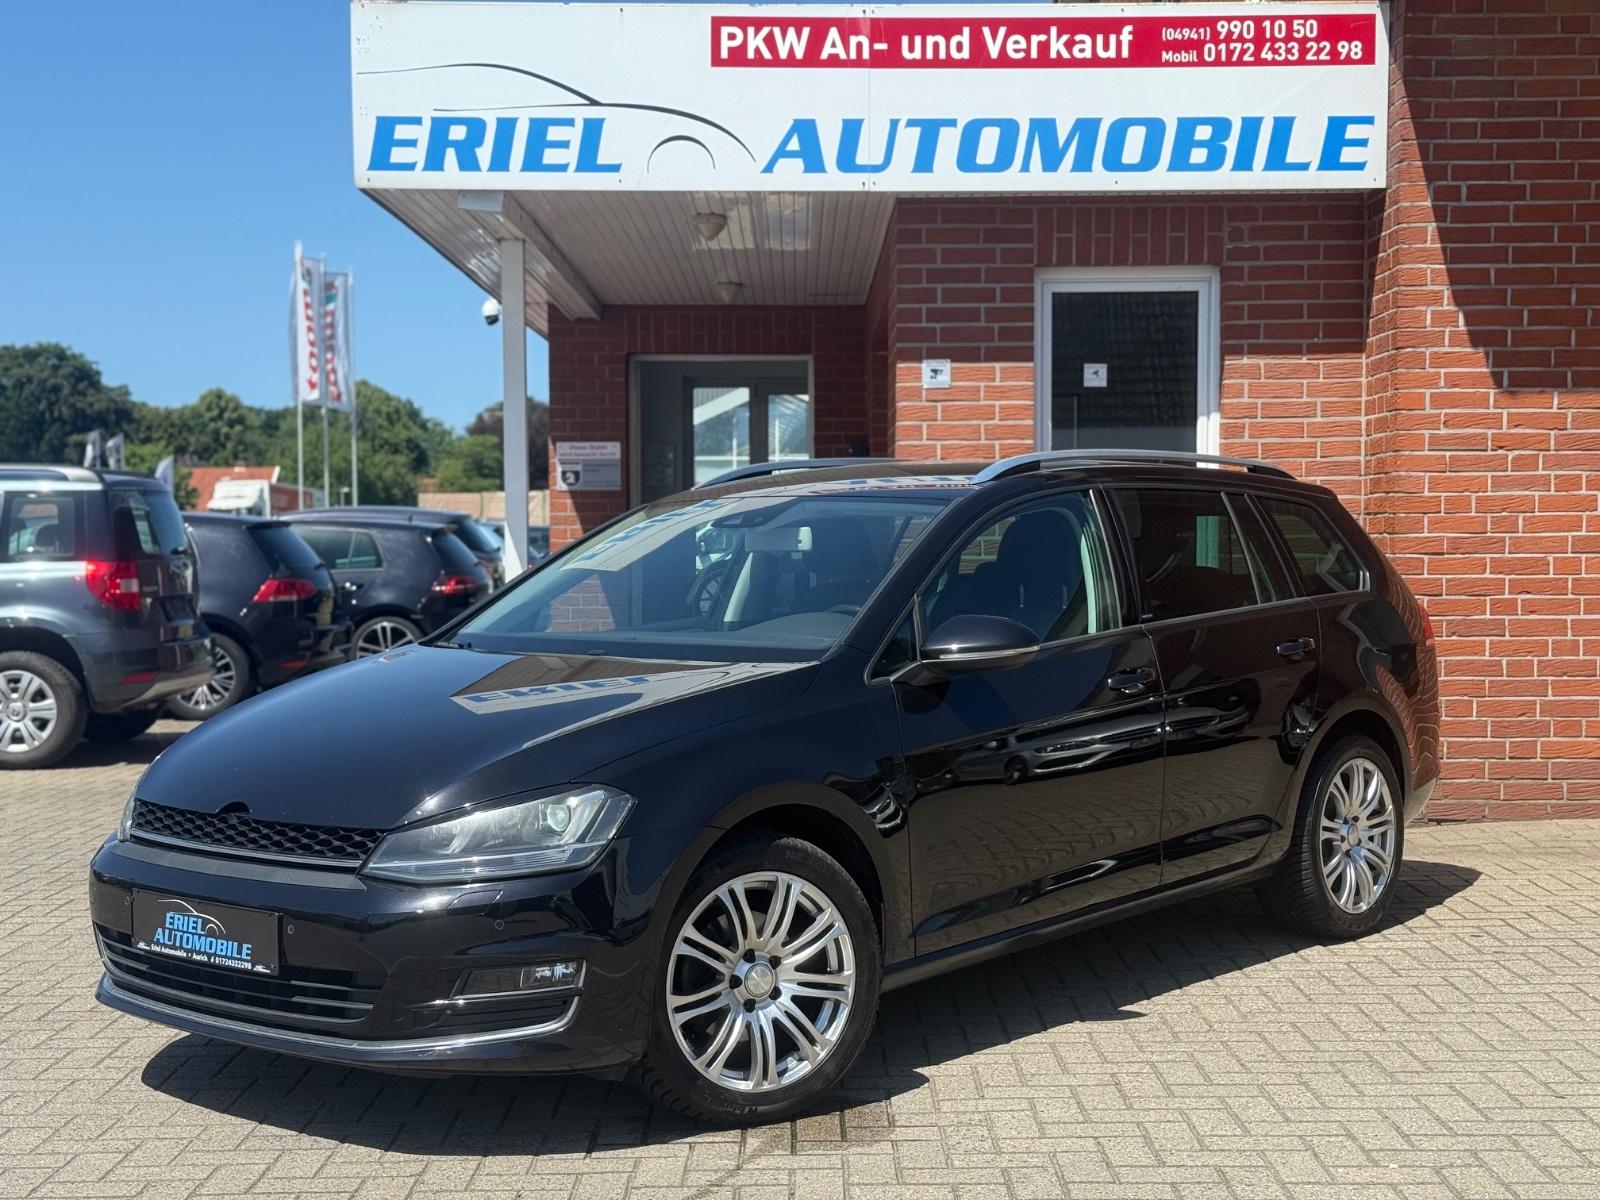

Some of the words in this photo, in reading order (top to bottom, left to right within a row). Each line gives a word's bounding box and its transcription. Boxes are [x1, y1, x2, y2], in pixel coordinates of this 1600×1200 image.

[719, 25, 811, 60] PKW
[819, 25, 889, 60] An-
[900, 26, 971, 60] und
[981, 25, 1134, 60] Verkauf
[1161, 26, 1211, 42] (04941)
[1216, 20, 1255, 40] 990
[1261, 19, 1287, 39] 10
[1292, 19, 1318, 38] 50
[1161, 49, 1199, 63] Mobil
[1203, 42, 1255, 62] 0172
[1260, 42, 1300, 61] 433
[1305, 41, 1331, 61] 22
[1336, 40, 1363, 60] 98
[366, 115, 623, 173] ERIEL
[759, 115, 1376, 174] AUTOMOBILE
[165, 911, 205, 935] ERIEL
[153, 927, 253, 960] AUTOMOBILE
